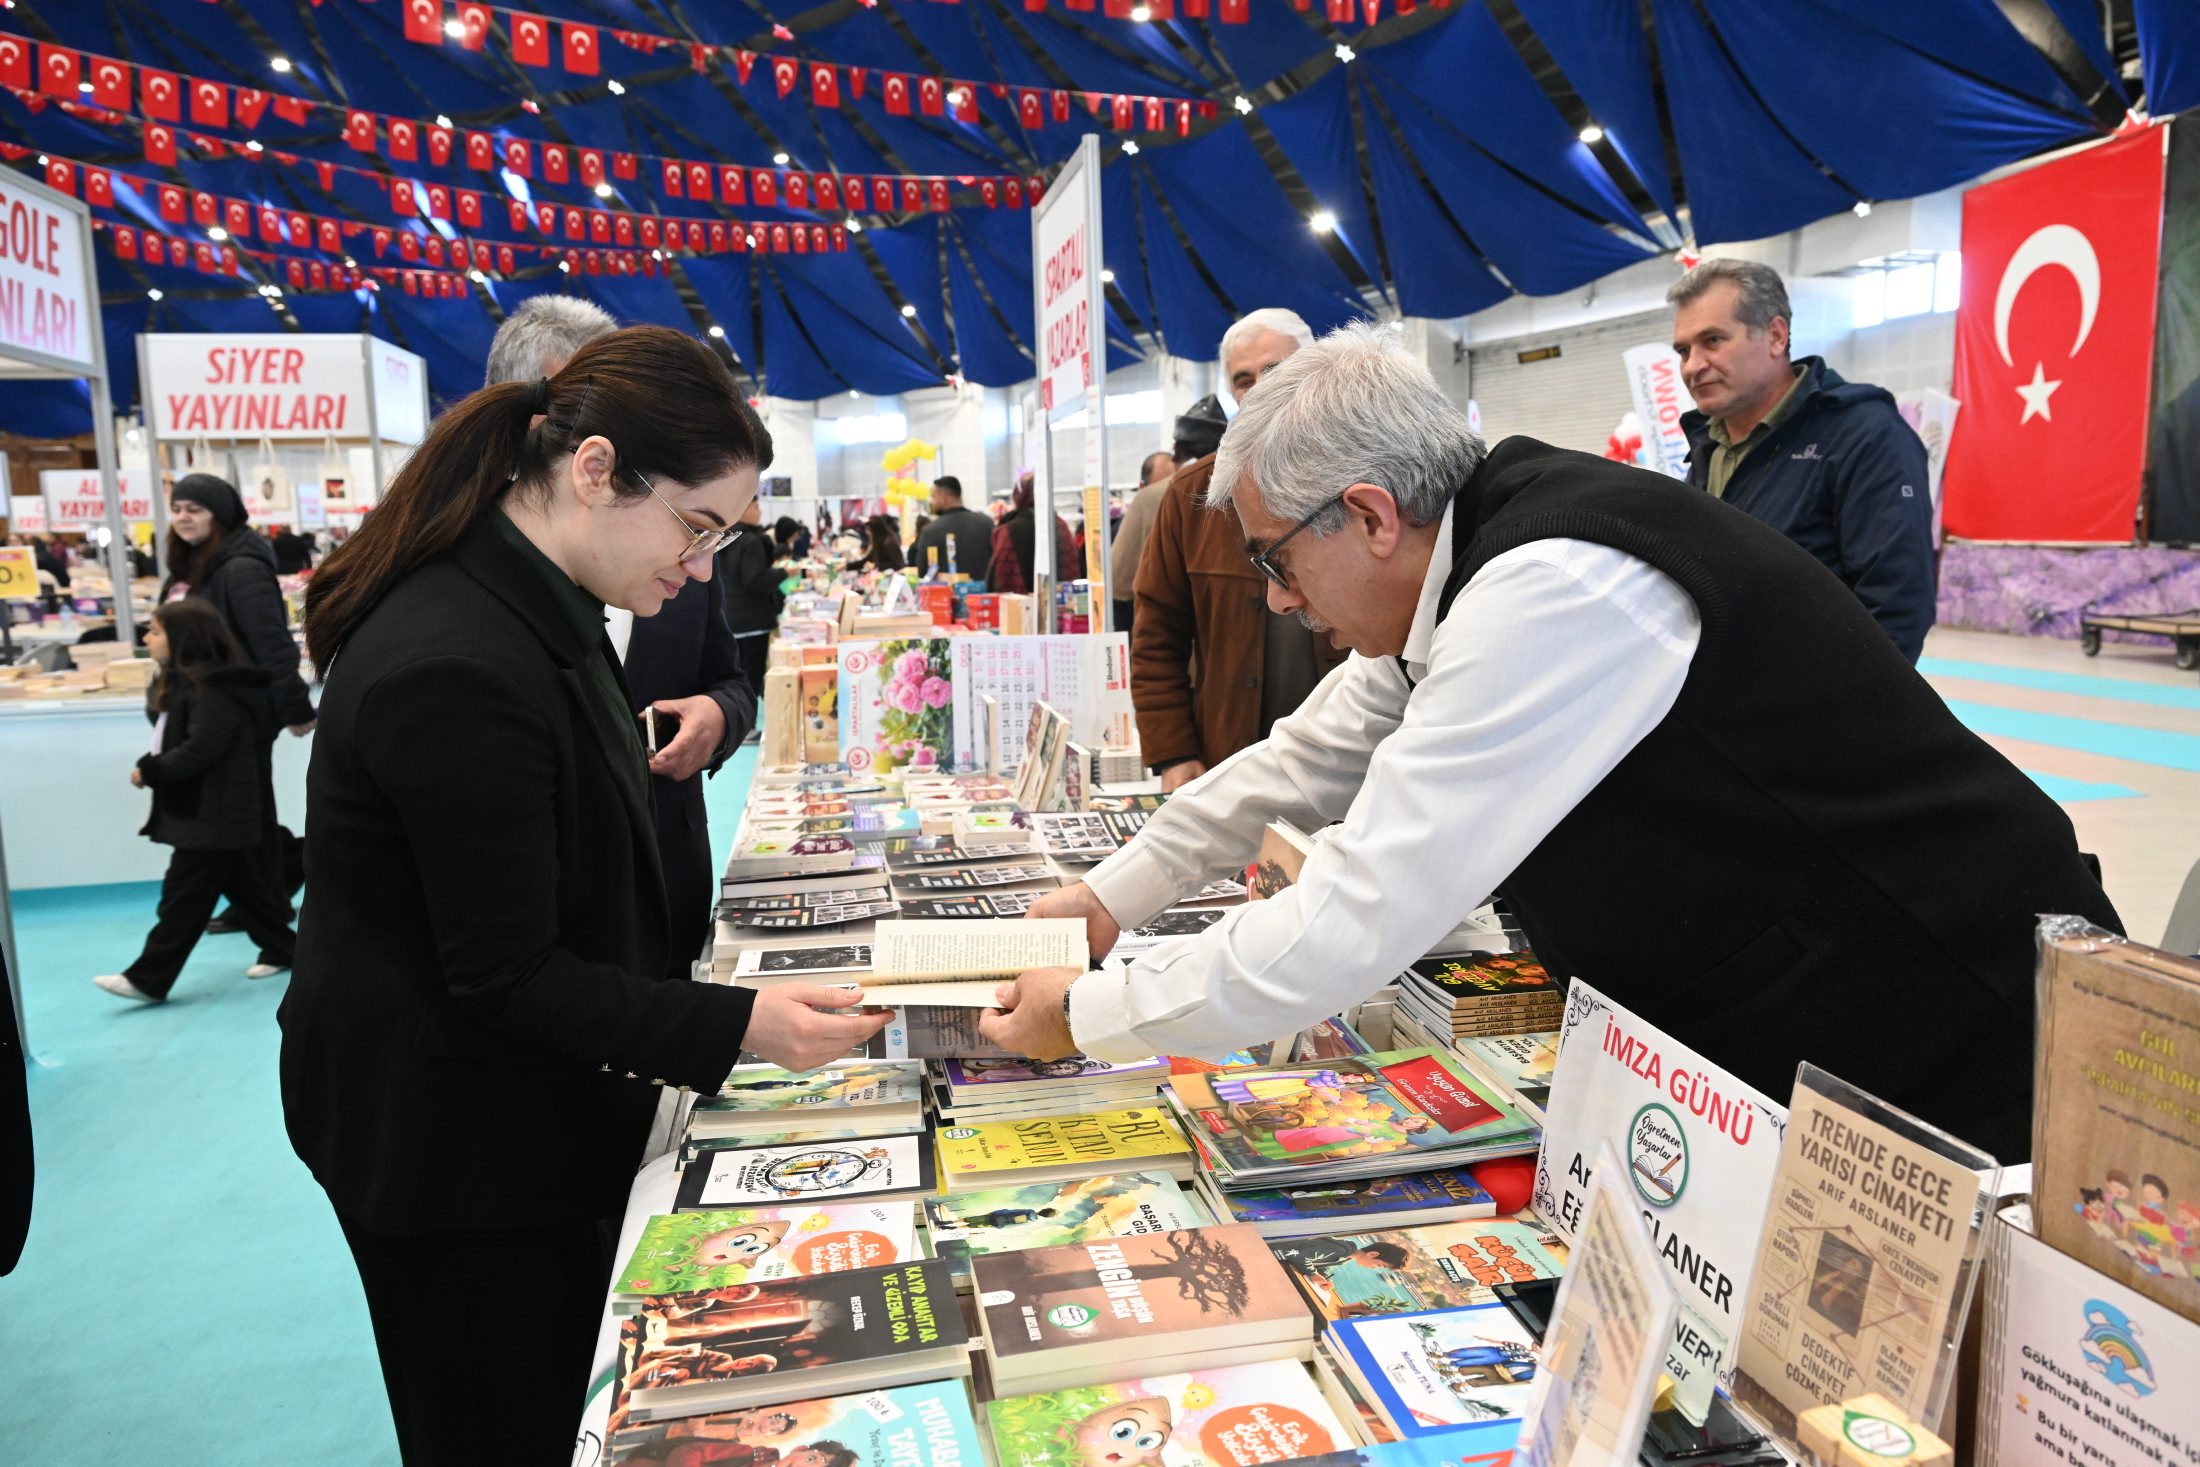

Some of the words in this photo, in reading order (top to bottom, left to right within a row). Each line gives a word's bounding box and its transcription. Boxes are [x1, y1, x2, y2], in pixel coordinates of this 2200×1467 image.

[167, 394, 347, 431] YAYINLARI
[1603, 1015, 1661, 1089] İMZA
[1669, 1068, 1754, 1146] GÜNÜ
[1636, 1129, 1672, 1161] Yazarlar
[1642, 1113, 1681, 1149] Öğretmen
[1799, 1133, 1857, 1186] YARISI
[1812, 1108, 1888, 1172] TRENDE
[1891, 1154, 1953, 1207] GECE
[1132, 1220, 1148, 1234] GİD
[1140, 1204, 1163, 1232] BAŞARI
[1849, 1197, 1917, 1248] ARSLANER
[883, 1273, 899, 1287] VE
[904, 1265, 927, 1294] KAYIP
[1087, 1243, 1142, 1299] ZENGİN
[885, 1287, 912, 1321] GİZEMLİ
[911, 1296, 939, 1343] ANAHTAR
[891, 1321, 911, 1344] ODA
[1801, 1333, 1856, 1380] DEDEKTİF
[1801, 1354, 1846, 1397] CİNAYET
[1785, 1362, 1821, 1403] ÇÖZME
[2021, 1345, 2112, 1408] Gökkuşağına
[2115, 1403, 2181, 1451] ulaşmak
[2021, 1367, 2081, 1412] yağmura
[2084, 1403, 2164, 1464] katlanmak
[2037, 1410, 2055, 1430] Bu
[2059, 1423, 2078, 1445] bir
[2034, 1431, 2065, 1458] ama
